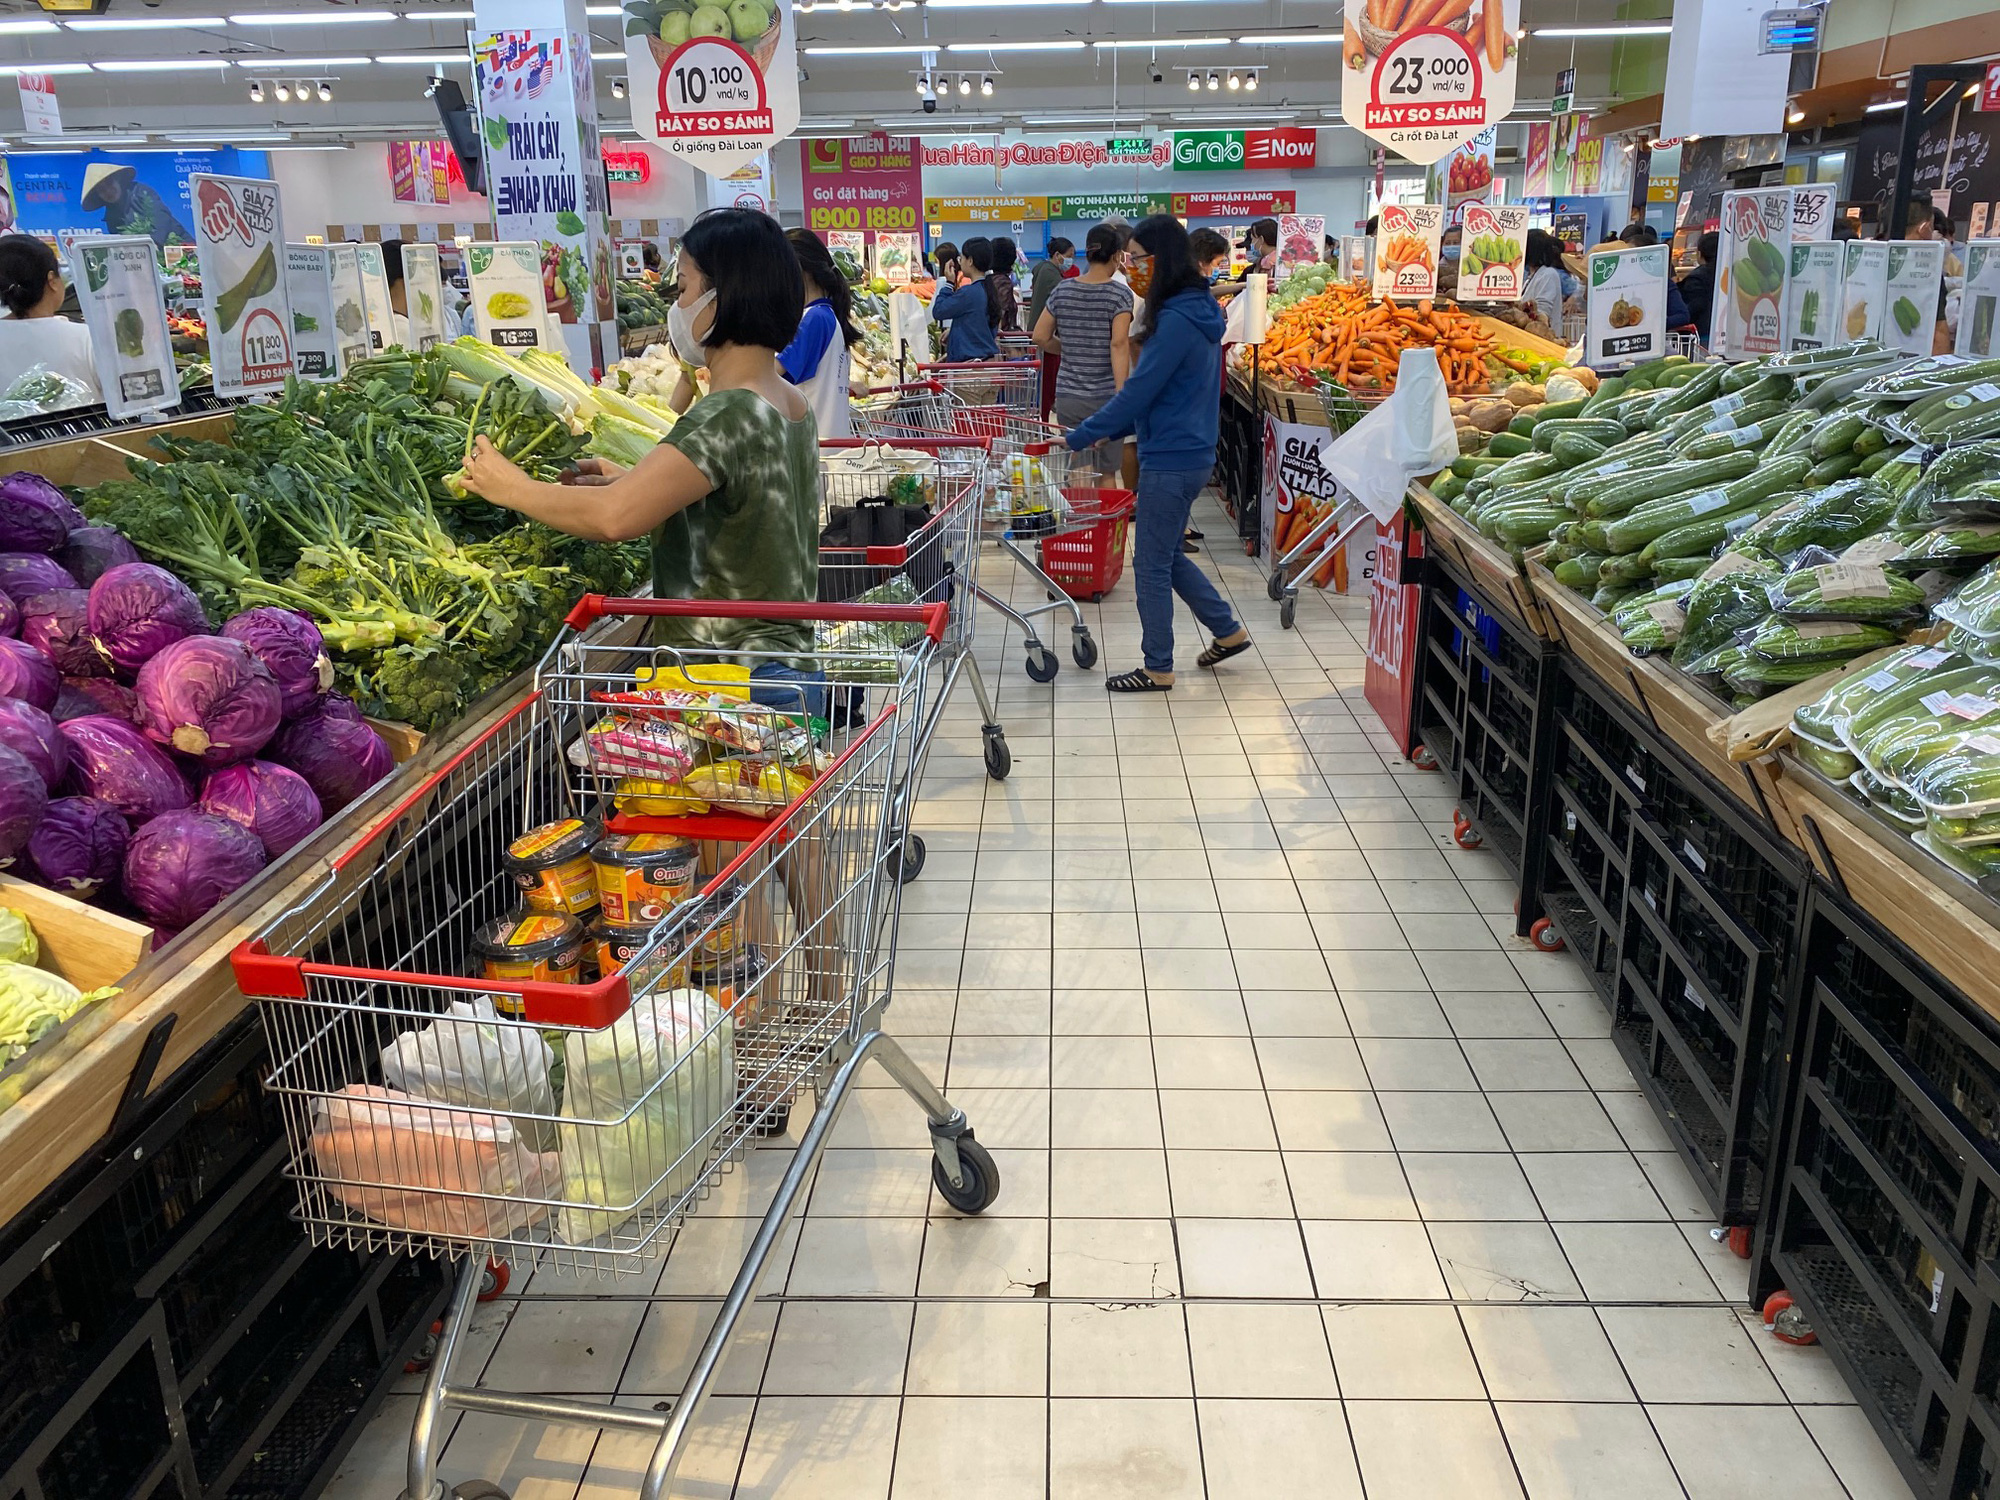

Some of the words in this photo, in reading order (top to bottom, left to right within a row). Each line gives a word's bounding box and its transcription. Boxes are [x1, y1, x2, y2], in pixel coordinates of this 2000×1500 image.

[738, 88, 749, 100] kg
[1454, 80, 1465, 93] kg
[1368, 107, 1405, 124] HÃY
[1407, 108, 1432, 122] SO
[1434, 104, 1483, 120] SÁNH
[659, 116, 694, 132] HÃY
[697, 117, 721, 131] SO
[723, 113, 771, 130] SÁNH
[506, 112, 537, 161] TRÁI
[537, 111, 560, 160] CÂY
[1390, 131, 1404, 142] Cà
[1406, 129, 1422, 141] rốt
[1425, 131, 1439, 141] Đà
[1442, 130, 1459, 142] Lạt
[686, 140, 716, 153] giống
[718, 140, 735, 150] Đài
[738, 140, 763, 150] Loan
[1113, 139, 1145, 148] EXIT
[1175, 133, 1244, 164] Grab
[1271, 140, 1314, 157] Now
[850, 155, 877, 168] GIAO
[880, 153, 912, 168] HÀNG
[952, 143, 1010, 168] Hàng
[1012, 143, 1056, 165] Qua
[1057, 141, 1107, 167] Điện
[15, 181, 72, 191] CENTRAL
[500, 165, 540, 226] NHẬP
[542, 152, 577, 213] KHẨU
[243, 187, 263, 205] GIÁ
[813, 187, 834, 203] Gọi
[837, 186, 857, 203] đặt
[860, 186, 889, 201] hàng
[963, 196, 992, 208] NHẬN
[993, 196, 1025, 207] HÀNG
[1086, 195, 1116, 207] NHẬN
[1210, 192, 1242, 205] NHẬN
[1243, 191, 1273, 202] HÀNG
[811, 206, 860, 229] 1900
[866, 205, 916, 229] 1880
[970, 209, 989, 221] Big
[991, 209, 1000, 219] C
[1077, 206, 1138, 219] GrabMart
[1221, 205, 1250, 216] Now
[245, 211, 274, 233] THẤP
[1013, 222, 1022, 231] 04
[244, 367, 260, 382] HÃY
[261, 369, 272, 380] SO
[1285, 437, 1321, 461] GIÁ
[1282, 467, 1335, 499] THẤP
